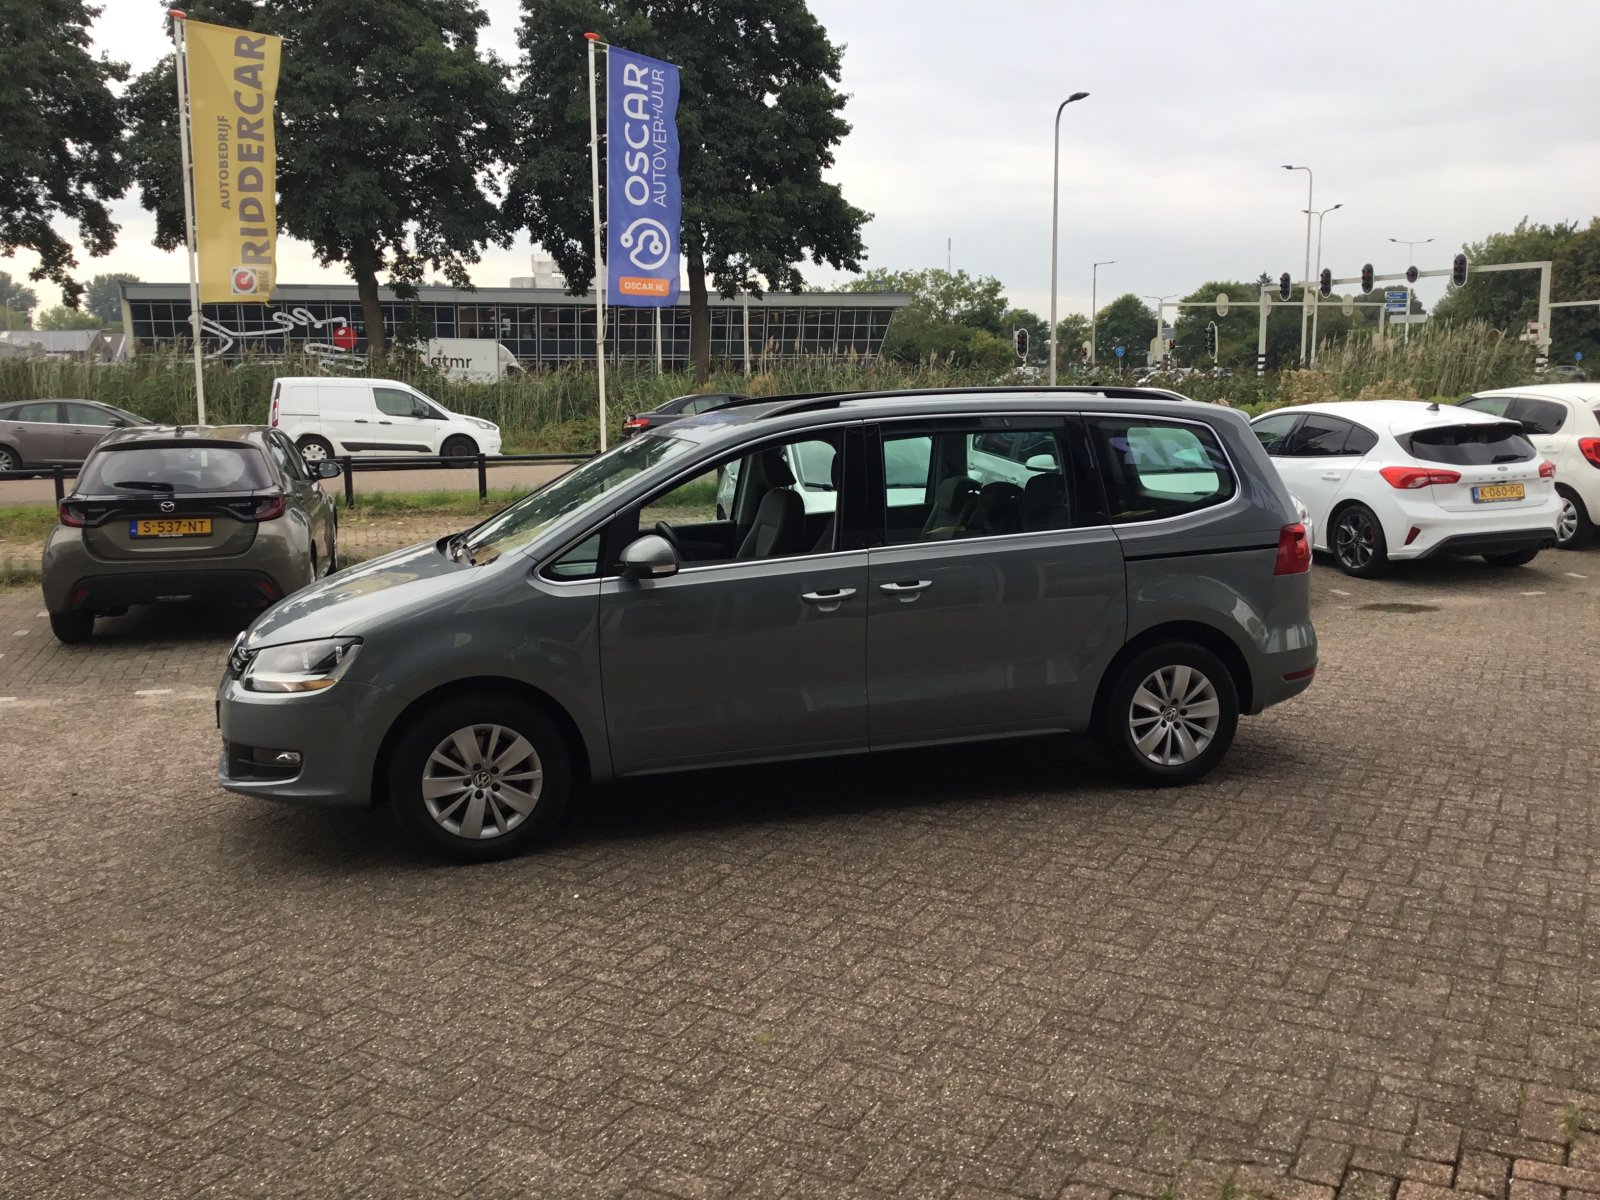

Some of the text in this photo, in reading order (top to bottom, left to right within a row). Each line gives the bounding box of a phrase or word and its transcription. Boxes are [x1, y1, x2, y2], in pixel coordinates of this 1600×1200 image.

[218, 115, 233, 210] AUTOBEDRIJF
[233, 35, 272, 264] RIDDERCAR
[623, 62, 650, 206] OSCAR
[651, 69, 667, 208] AUTOVERHUUR
[624, 281, 665, 292] OSCAR.NL
[143, 520, 205, 533] S-537-NT
[1480, 485, 1522, 498] K-060-PG
